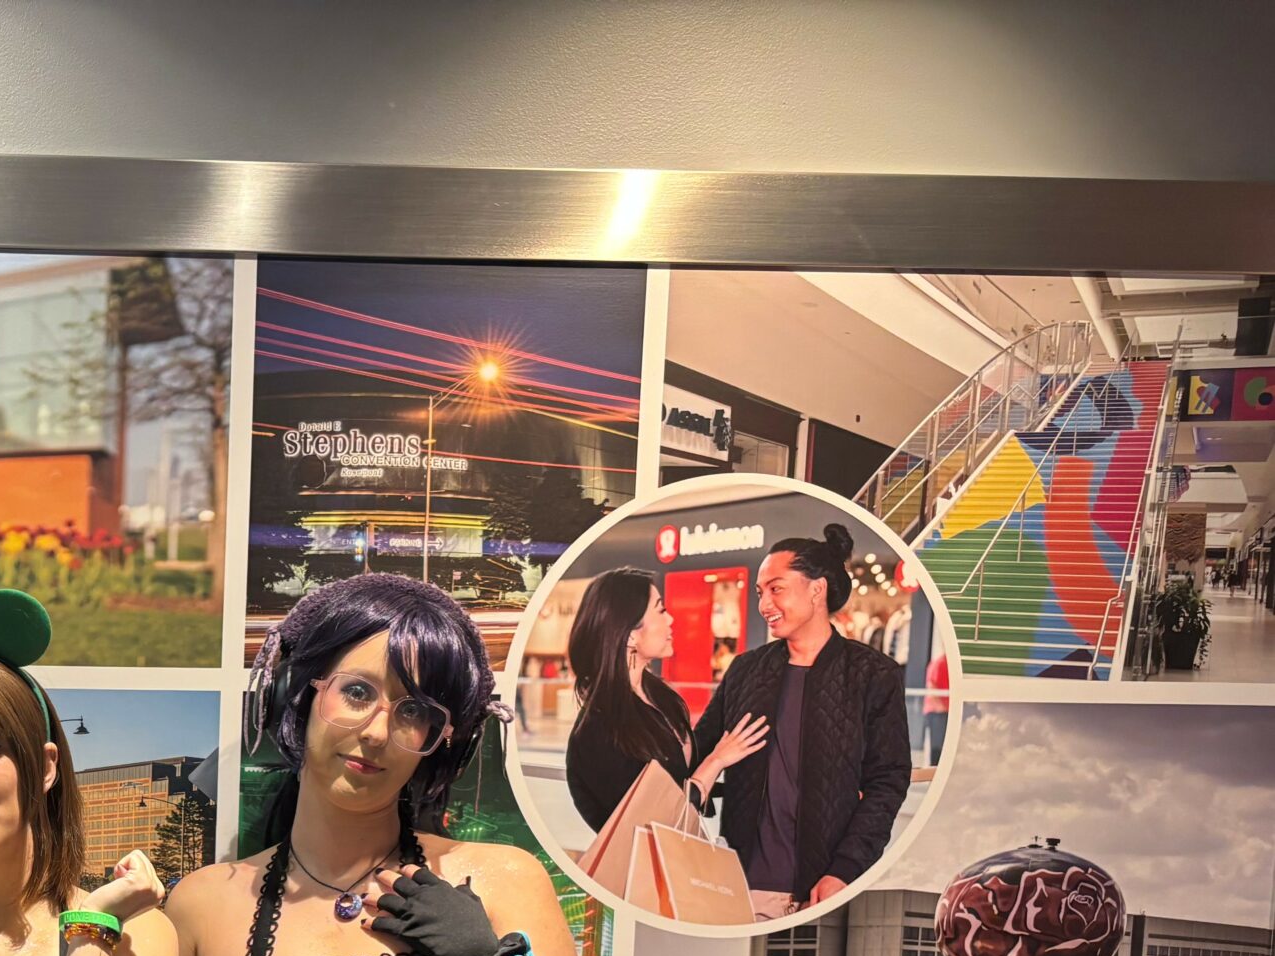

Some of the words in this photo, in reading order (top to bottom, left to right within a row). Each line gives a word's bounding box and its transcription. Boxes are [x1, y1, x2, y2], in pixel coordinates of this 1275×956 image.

[283, 428, 422, 461] Stephens
[341, 455, 420, 467] CONVENTION
[423, 456, 469, 470] CENTER
